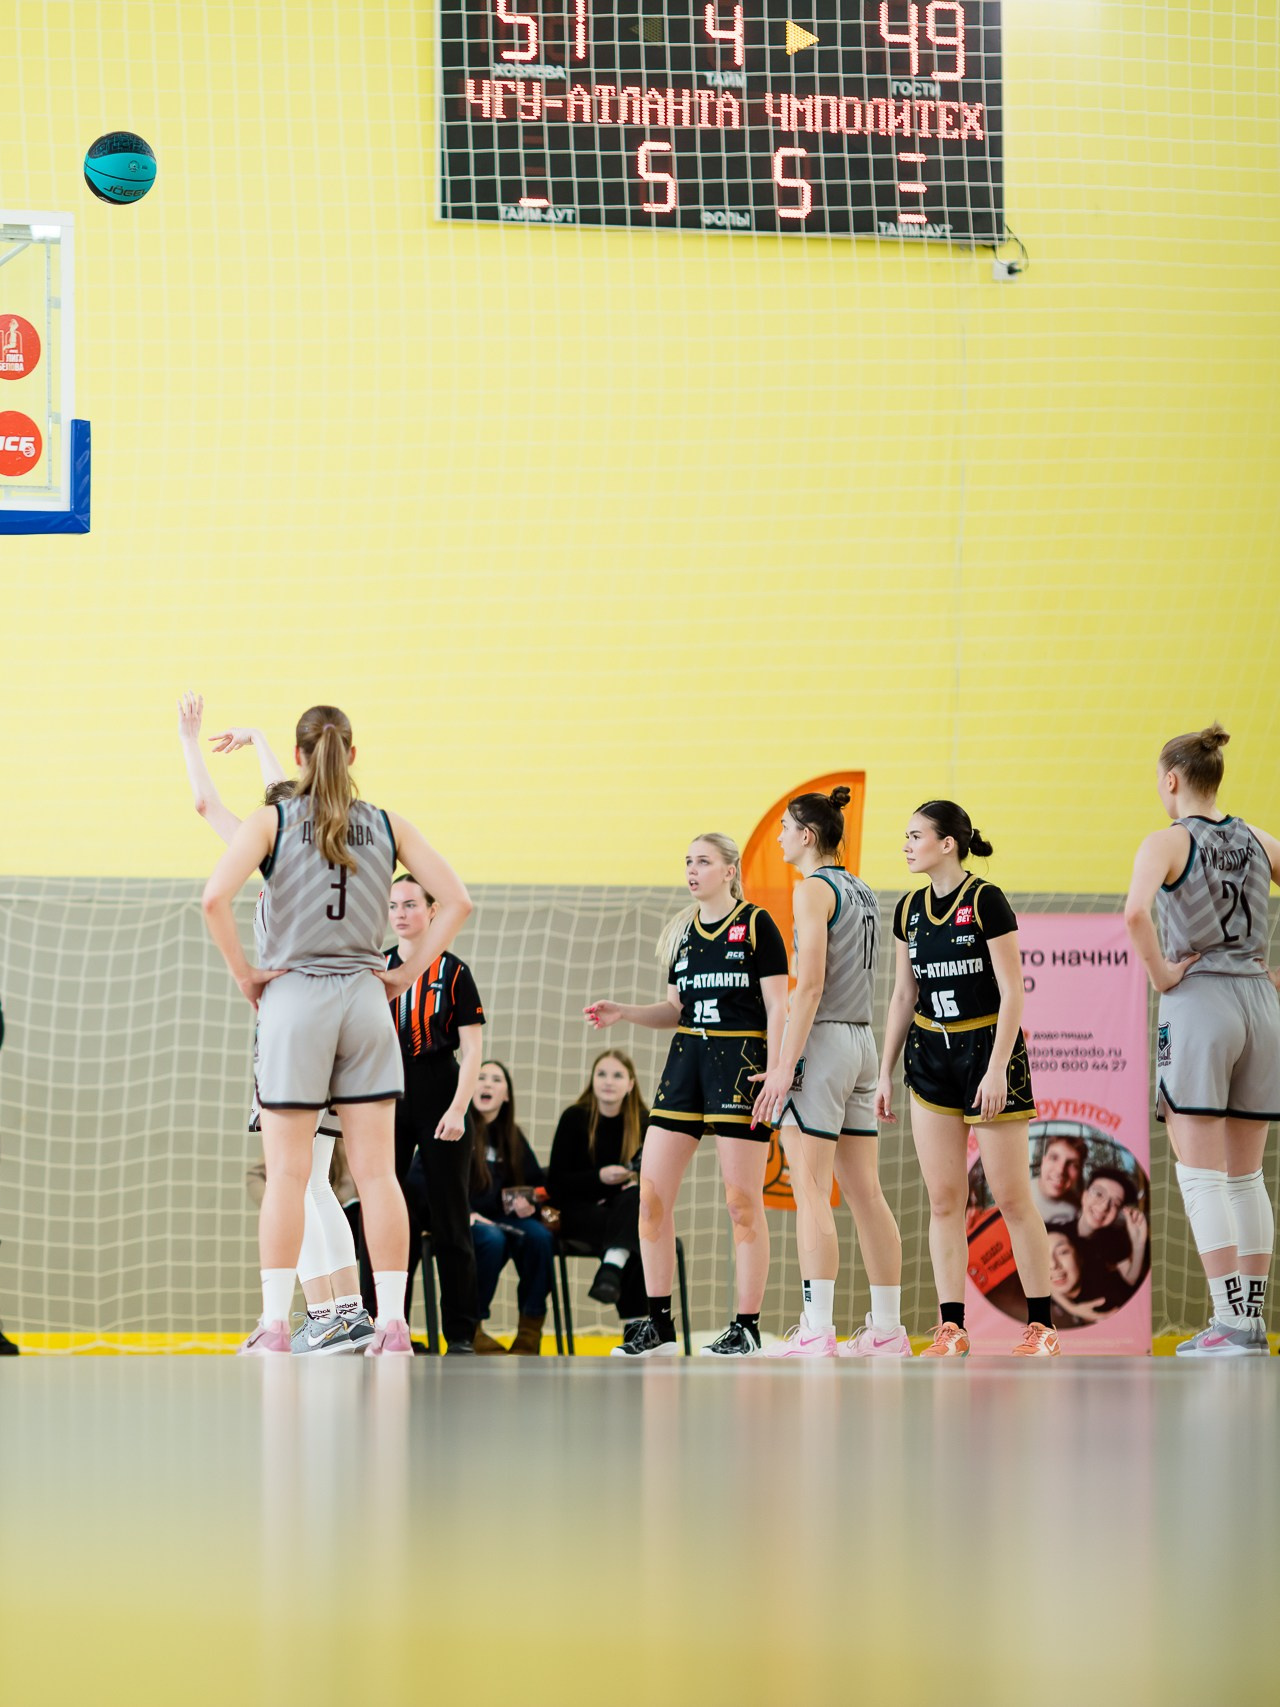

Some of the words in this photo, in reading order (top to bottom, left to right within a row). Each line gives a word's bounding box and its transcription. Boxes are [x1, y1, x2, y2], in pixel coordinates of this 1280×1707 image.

[704, 3, 744, 66] 4
[879, 1, 966, 82] 49
[704, 71, 747, 89] ТАЙМ
[891, 80, 942, 98] ГОСТИ
[466, 78, 741, 130] ЧГУ-АТЛАНТА
[637, 141, 676, 213] 5
[773, 146, 813, 219] 5
[700, 210, 751, 228] ФОЛЫ
[326, 860, 348, 921] 3
[1220, 874, 1252, 943] 21
[862, 915, 875, 970] 17
[912, 957, 984, 979] ГУ-АТЛАНТА
[1019, 950, 1045, 966] то
[1052, 950, 1128, 966] начни
[676, 972, 750, 992] ГУ-АТЛАНТА
[693, 998, 721, 1023] 15
[931, 990, 960, 1018] 16
[1028, 1046, 1122, 1058] abotavdodo.ru
[1035, 1099, 1123, 1131] рутится
